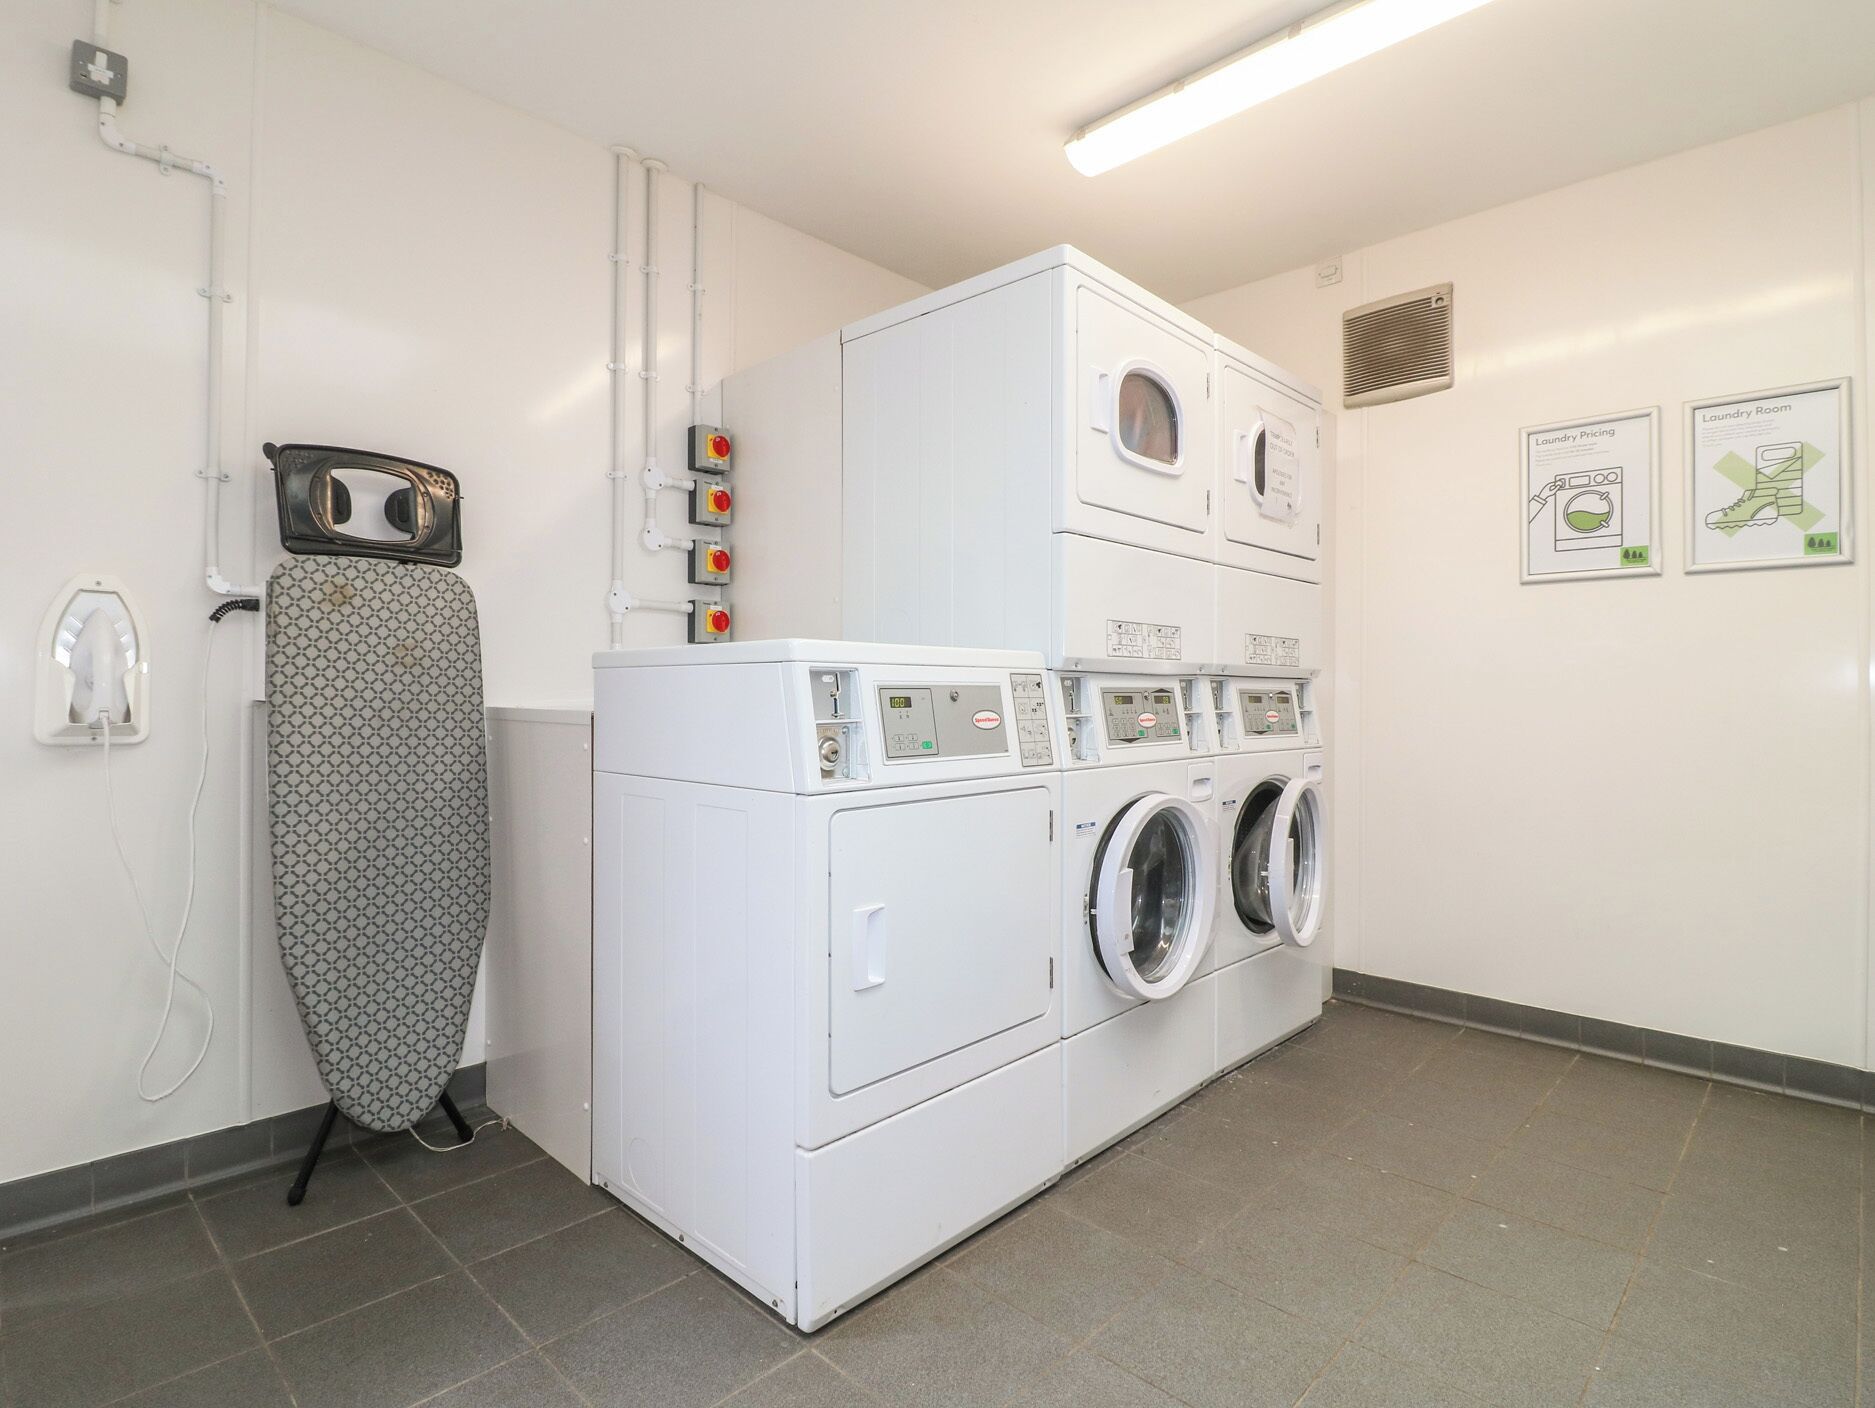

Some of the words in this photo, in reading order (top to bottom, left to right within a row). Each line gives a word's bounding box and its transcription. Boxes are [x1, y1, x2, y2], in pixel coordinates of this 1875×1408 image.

[1702, 409, 1752, 422] Laundry
[1756, 404, 1792, 415] Room
[1535, 433, 1578, 446] Laundry
[1580, 428, 1616, 440] Pricing
[891, 697, 905, 708] 100
